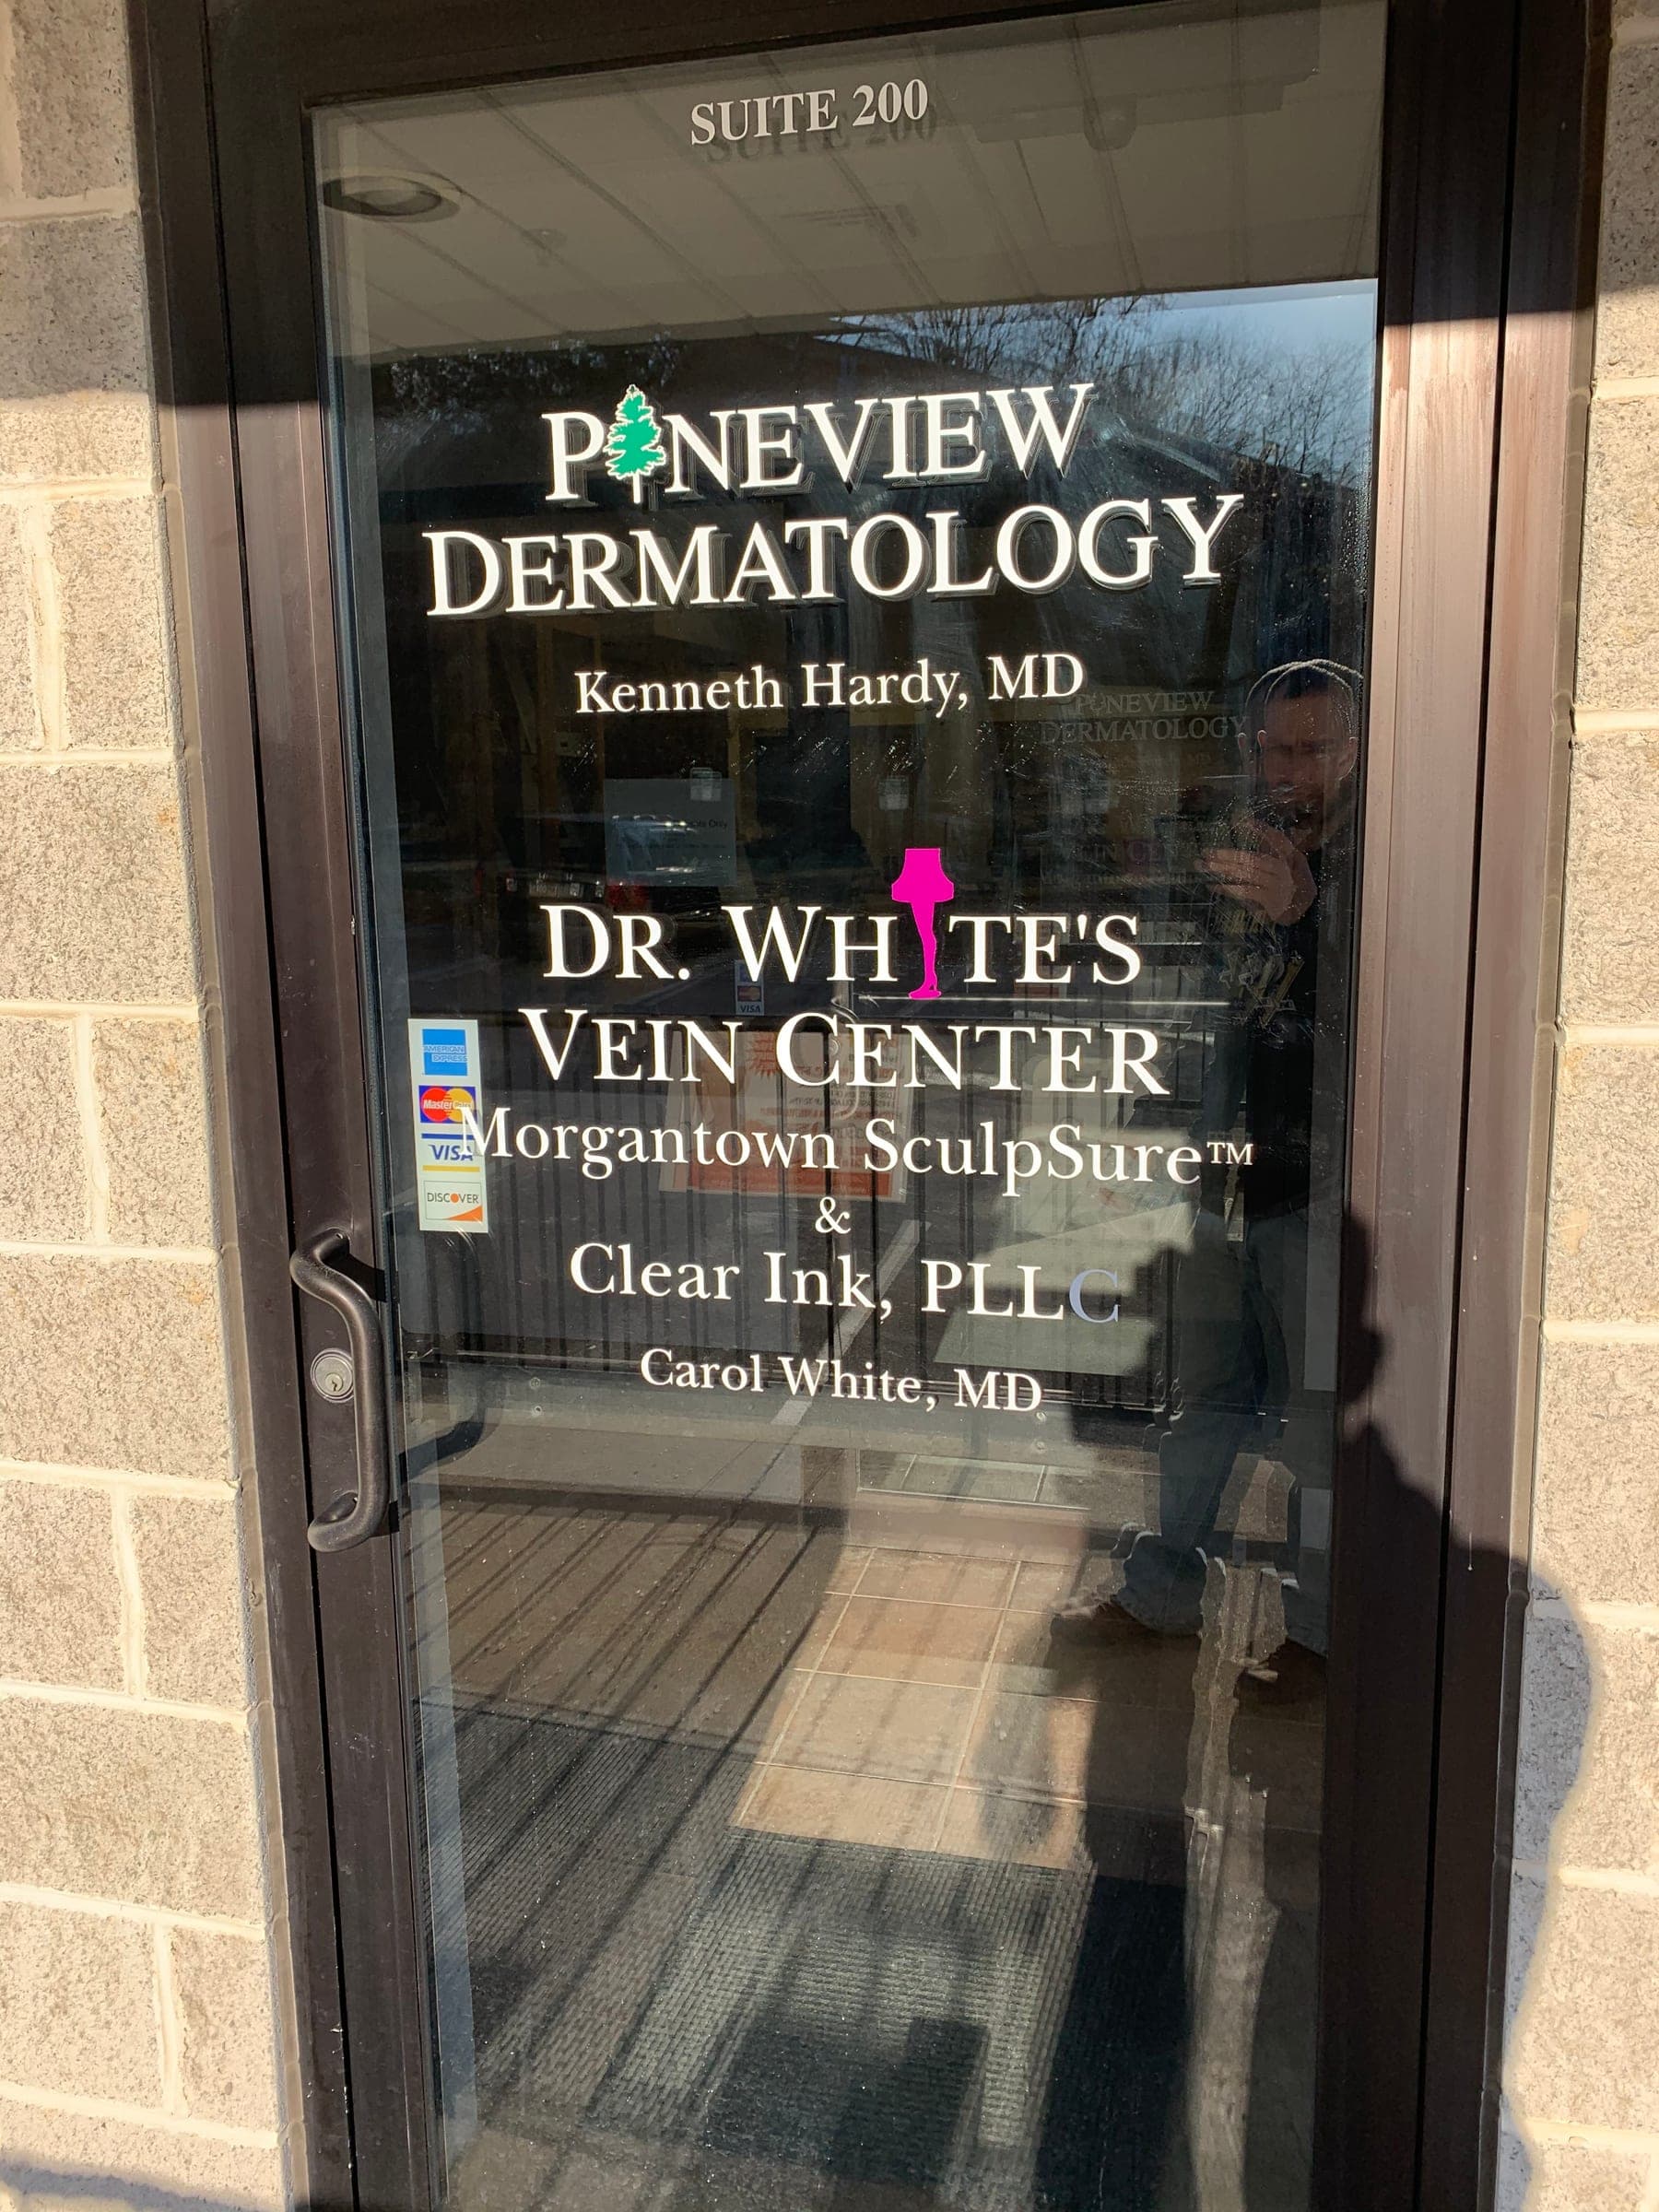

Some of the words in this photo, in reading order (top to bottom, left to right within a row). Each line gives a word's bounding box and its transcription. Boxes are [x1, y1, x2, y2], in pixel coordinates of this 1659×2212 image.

[691, 89, 838, 145] SUITE
[853, 79, 928, 126] 200
[423, 492, 1242, 618] DERMATOLOGY
[574, 665, 783, 713] Kenneth
[801, 658, 968, 718] Hardy,
[987, 653, 1083, 700] MD
[541, 905, 689, 981] DR.
[423, 1044, 465, 1053] AMERICAN
[432, 1053, 468, 1062] EXPRESS
[519, 1008, 743, 1084] VEIN
[777, 1012, 1170, 1095] CENTER
[459, 1106, 840, 1180] Morgantown
[427, 1192, 479, 1204] DISCOVER
[815, 1197, 852, 1234] &
[571, 1242, 740, 1300] Clear
[763, 1252, 892, 1321] Ink,
[921, 1259, 1119, 1323] PLLC
[641, 1347, 764, 1393] Carol
[777, 1356, 935, 1412] White,
[954, 1369, 1041, 1412] MD
